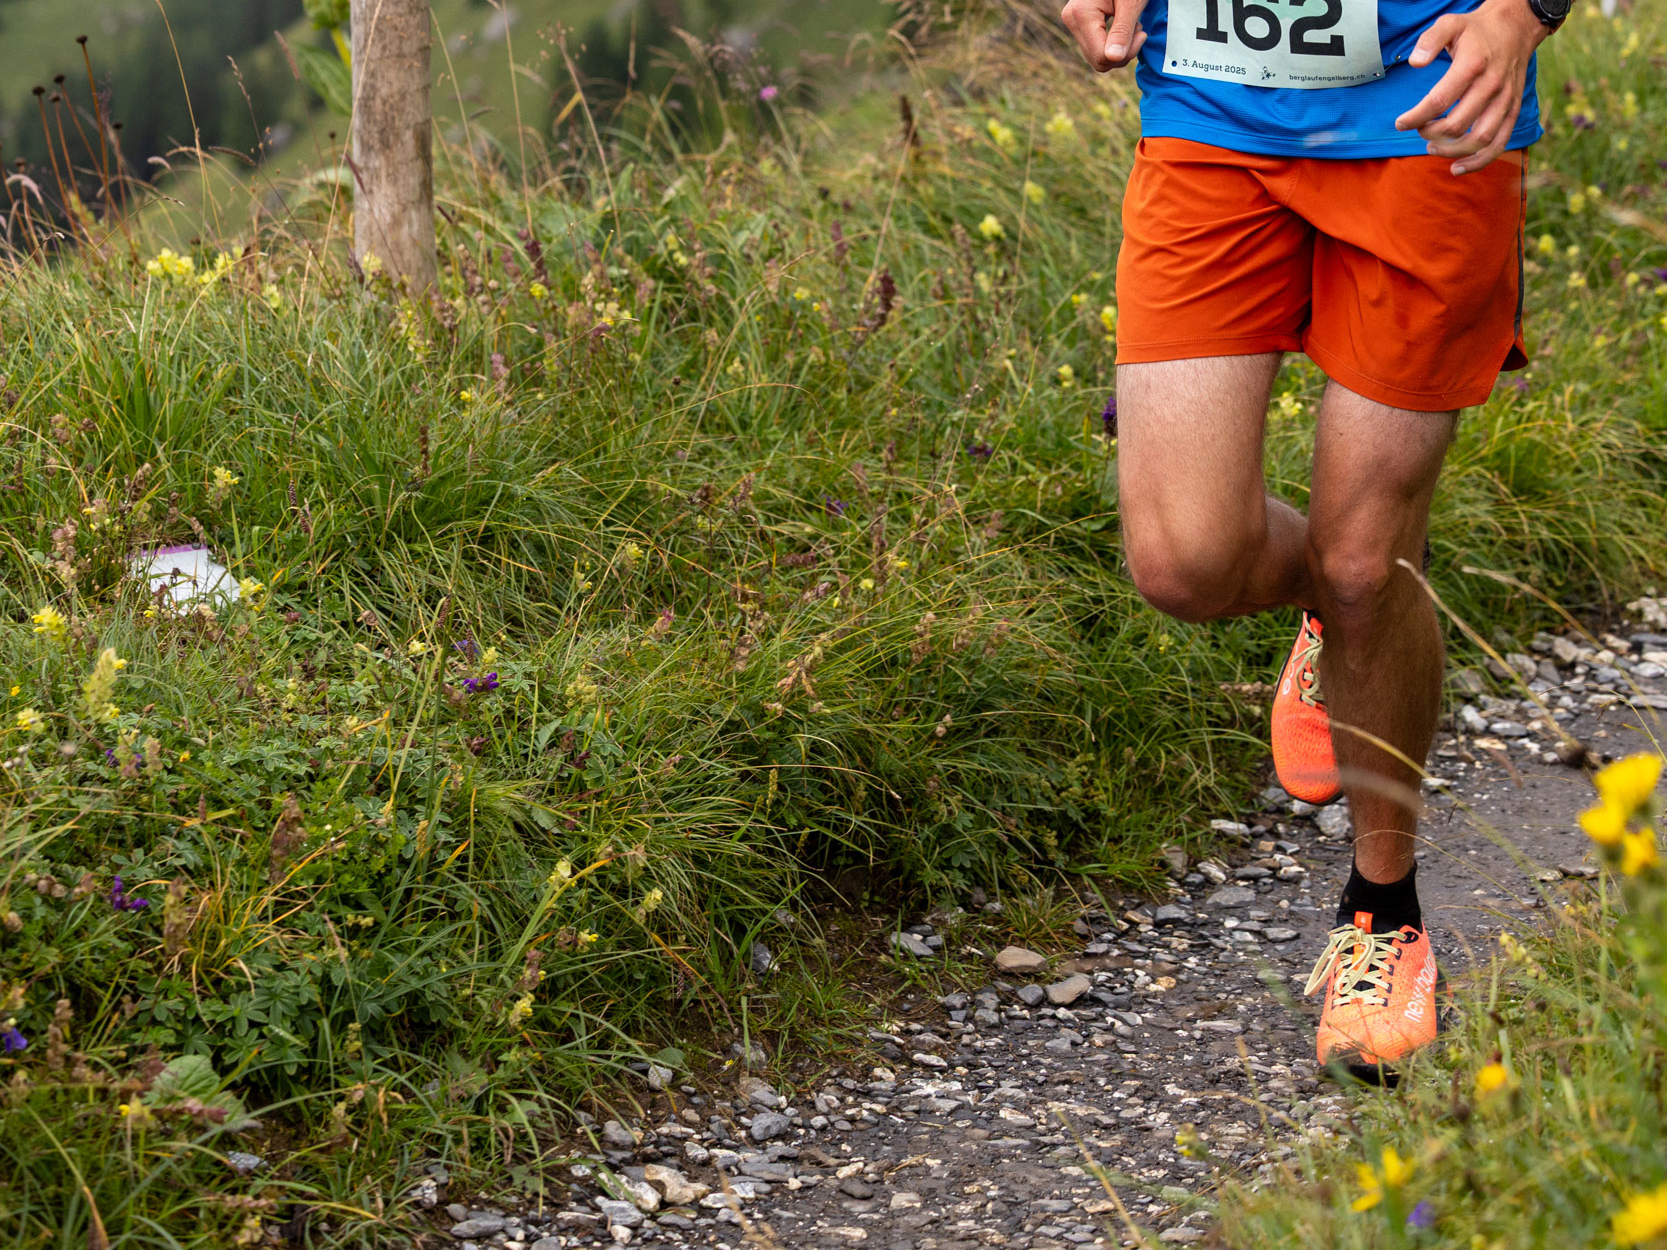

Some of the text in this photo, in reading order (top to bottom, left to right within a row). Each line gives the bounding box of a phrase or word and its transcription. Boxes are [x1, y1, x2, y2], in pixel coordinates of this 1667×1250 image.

[1182, 59, 1247, 76] 3. August 2025
[1289, 74, 1366, 83] berglaufengelberg.ch
[1404, 986, 1427, 1022] new
